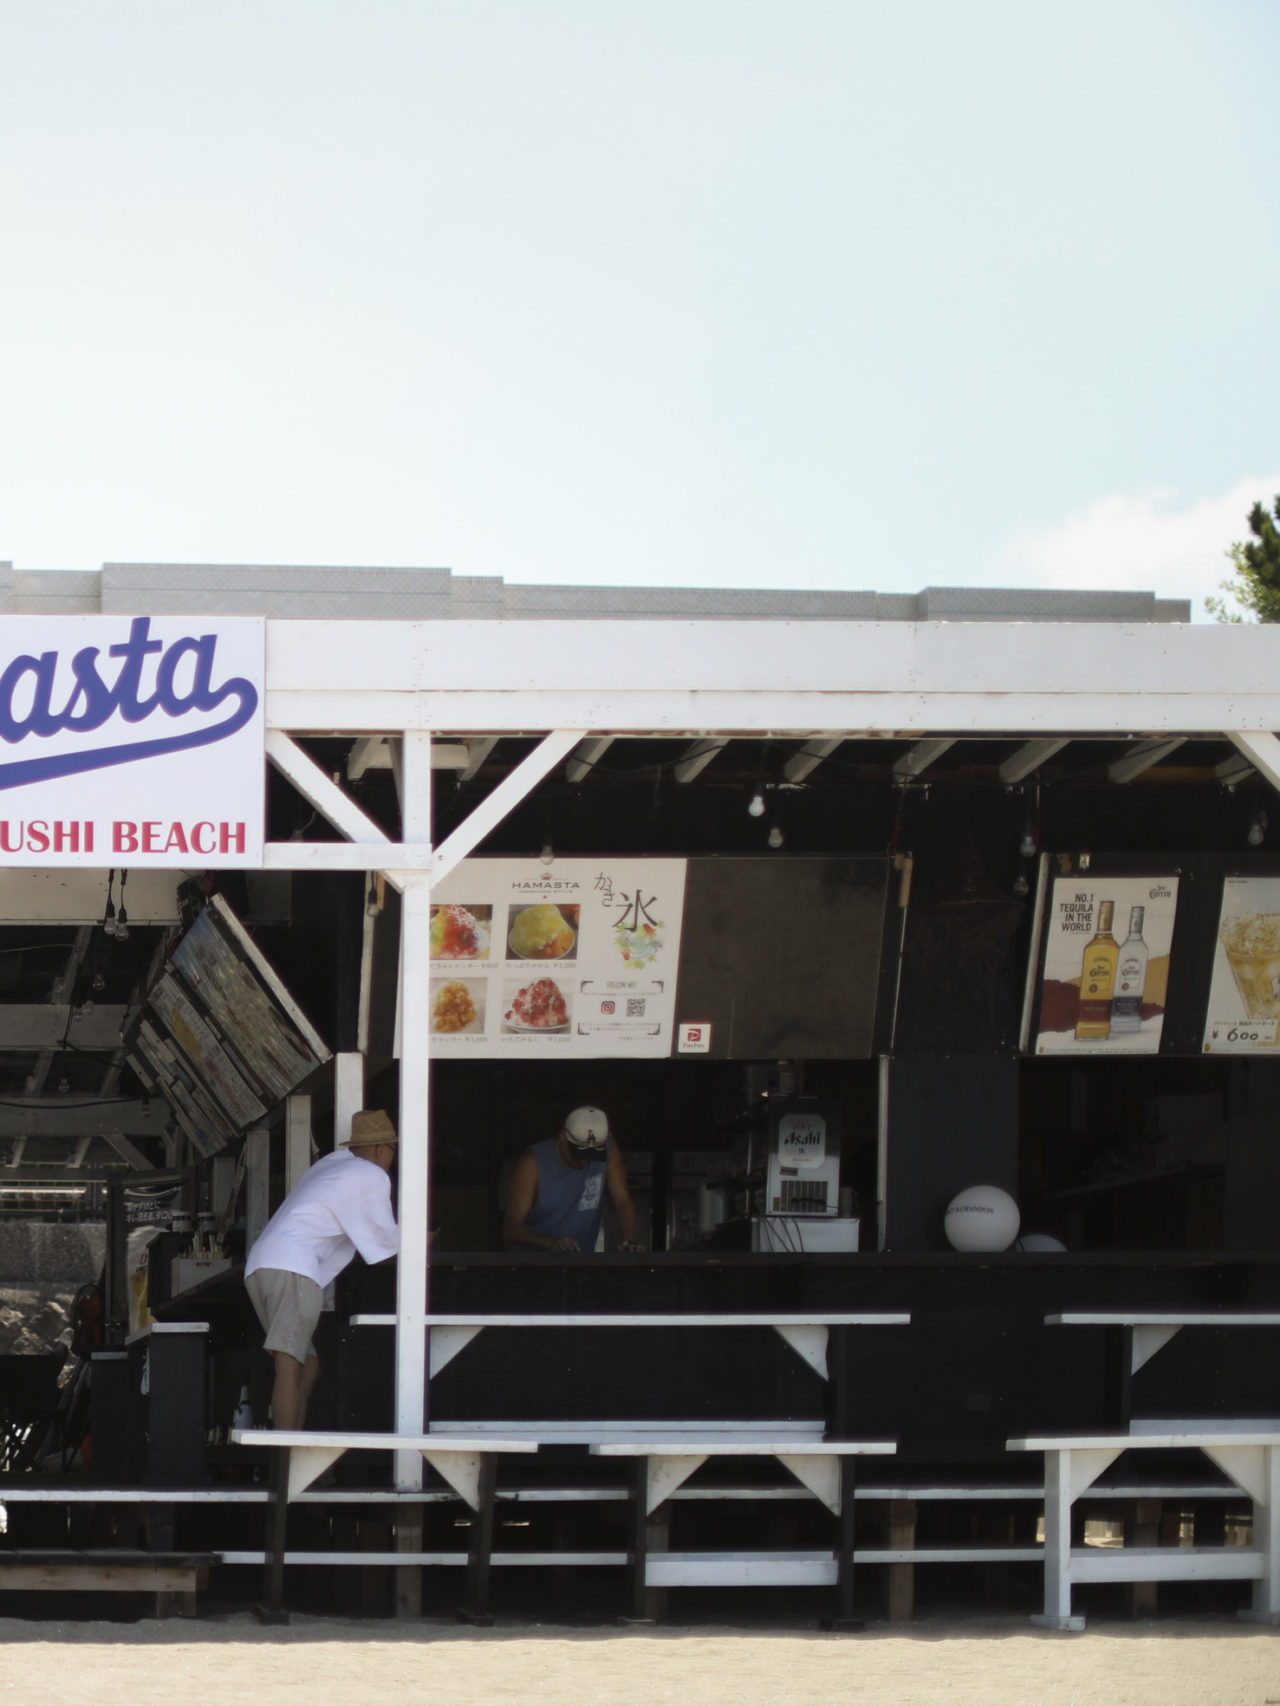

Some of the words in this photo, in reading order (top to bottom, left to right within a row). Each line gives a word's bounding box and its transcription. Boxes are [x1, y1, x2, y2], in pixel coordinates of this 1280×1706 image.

[112, 820, 247, 855] BEACH
[511, 881, 581, 889] HAMASTA
[1074, 893, 1094, 903] NO.1
[1059, 903, 1094, 912] TEQUILA
[1065, 912, 1075, 922] IN
[1077, 912, 1093, 922] THE
[1061, 922, 1092, 932] WORLD
[1227, 1027, 1259, 1042] 600
[784, 1131, 821, 1146] Asahi
